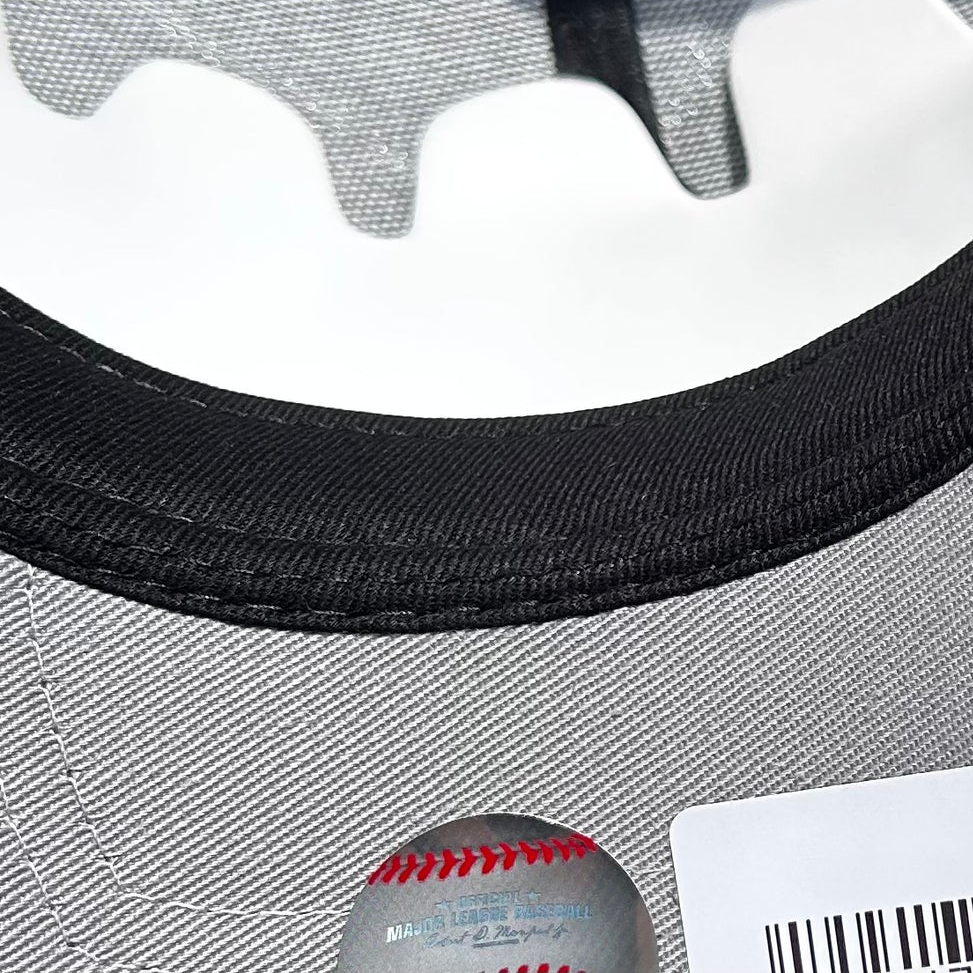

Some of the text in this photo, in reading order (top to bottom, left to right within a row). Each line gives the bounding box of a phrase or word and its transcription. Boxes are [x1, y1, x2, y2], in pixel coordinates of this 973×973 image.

[386, 903, 593, 944] MAJOR LEAGUE BASEBALL
